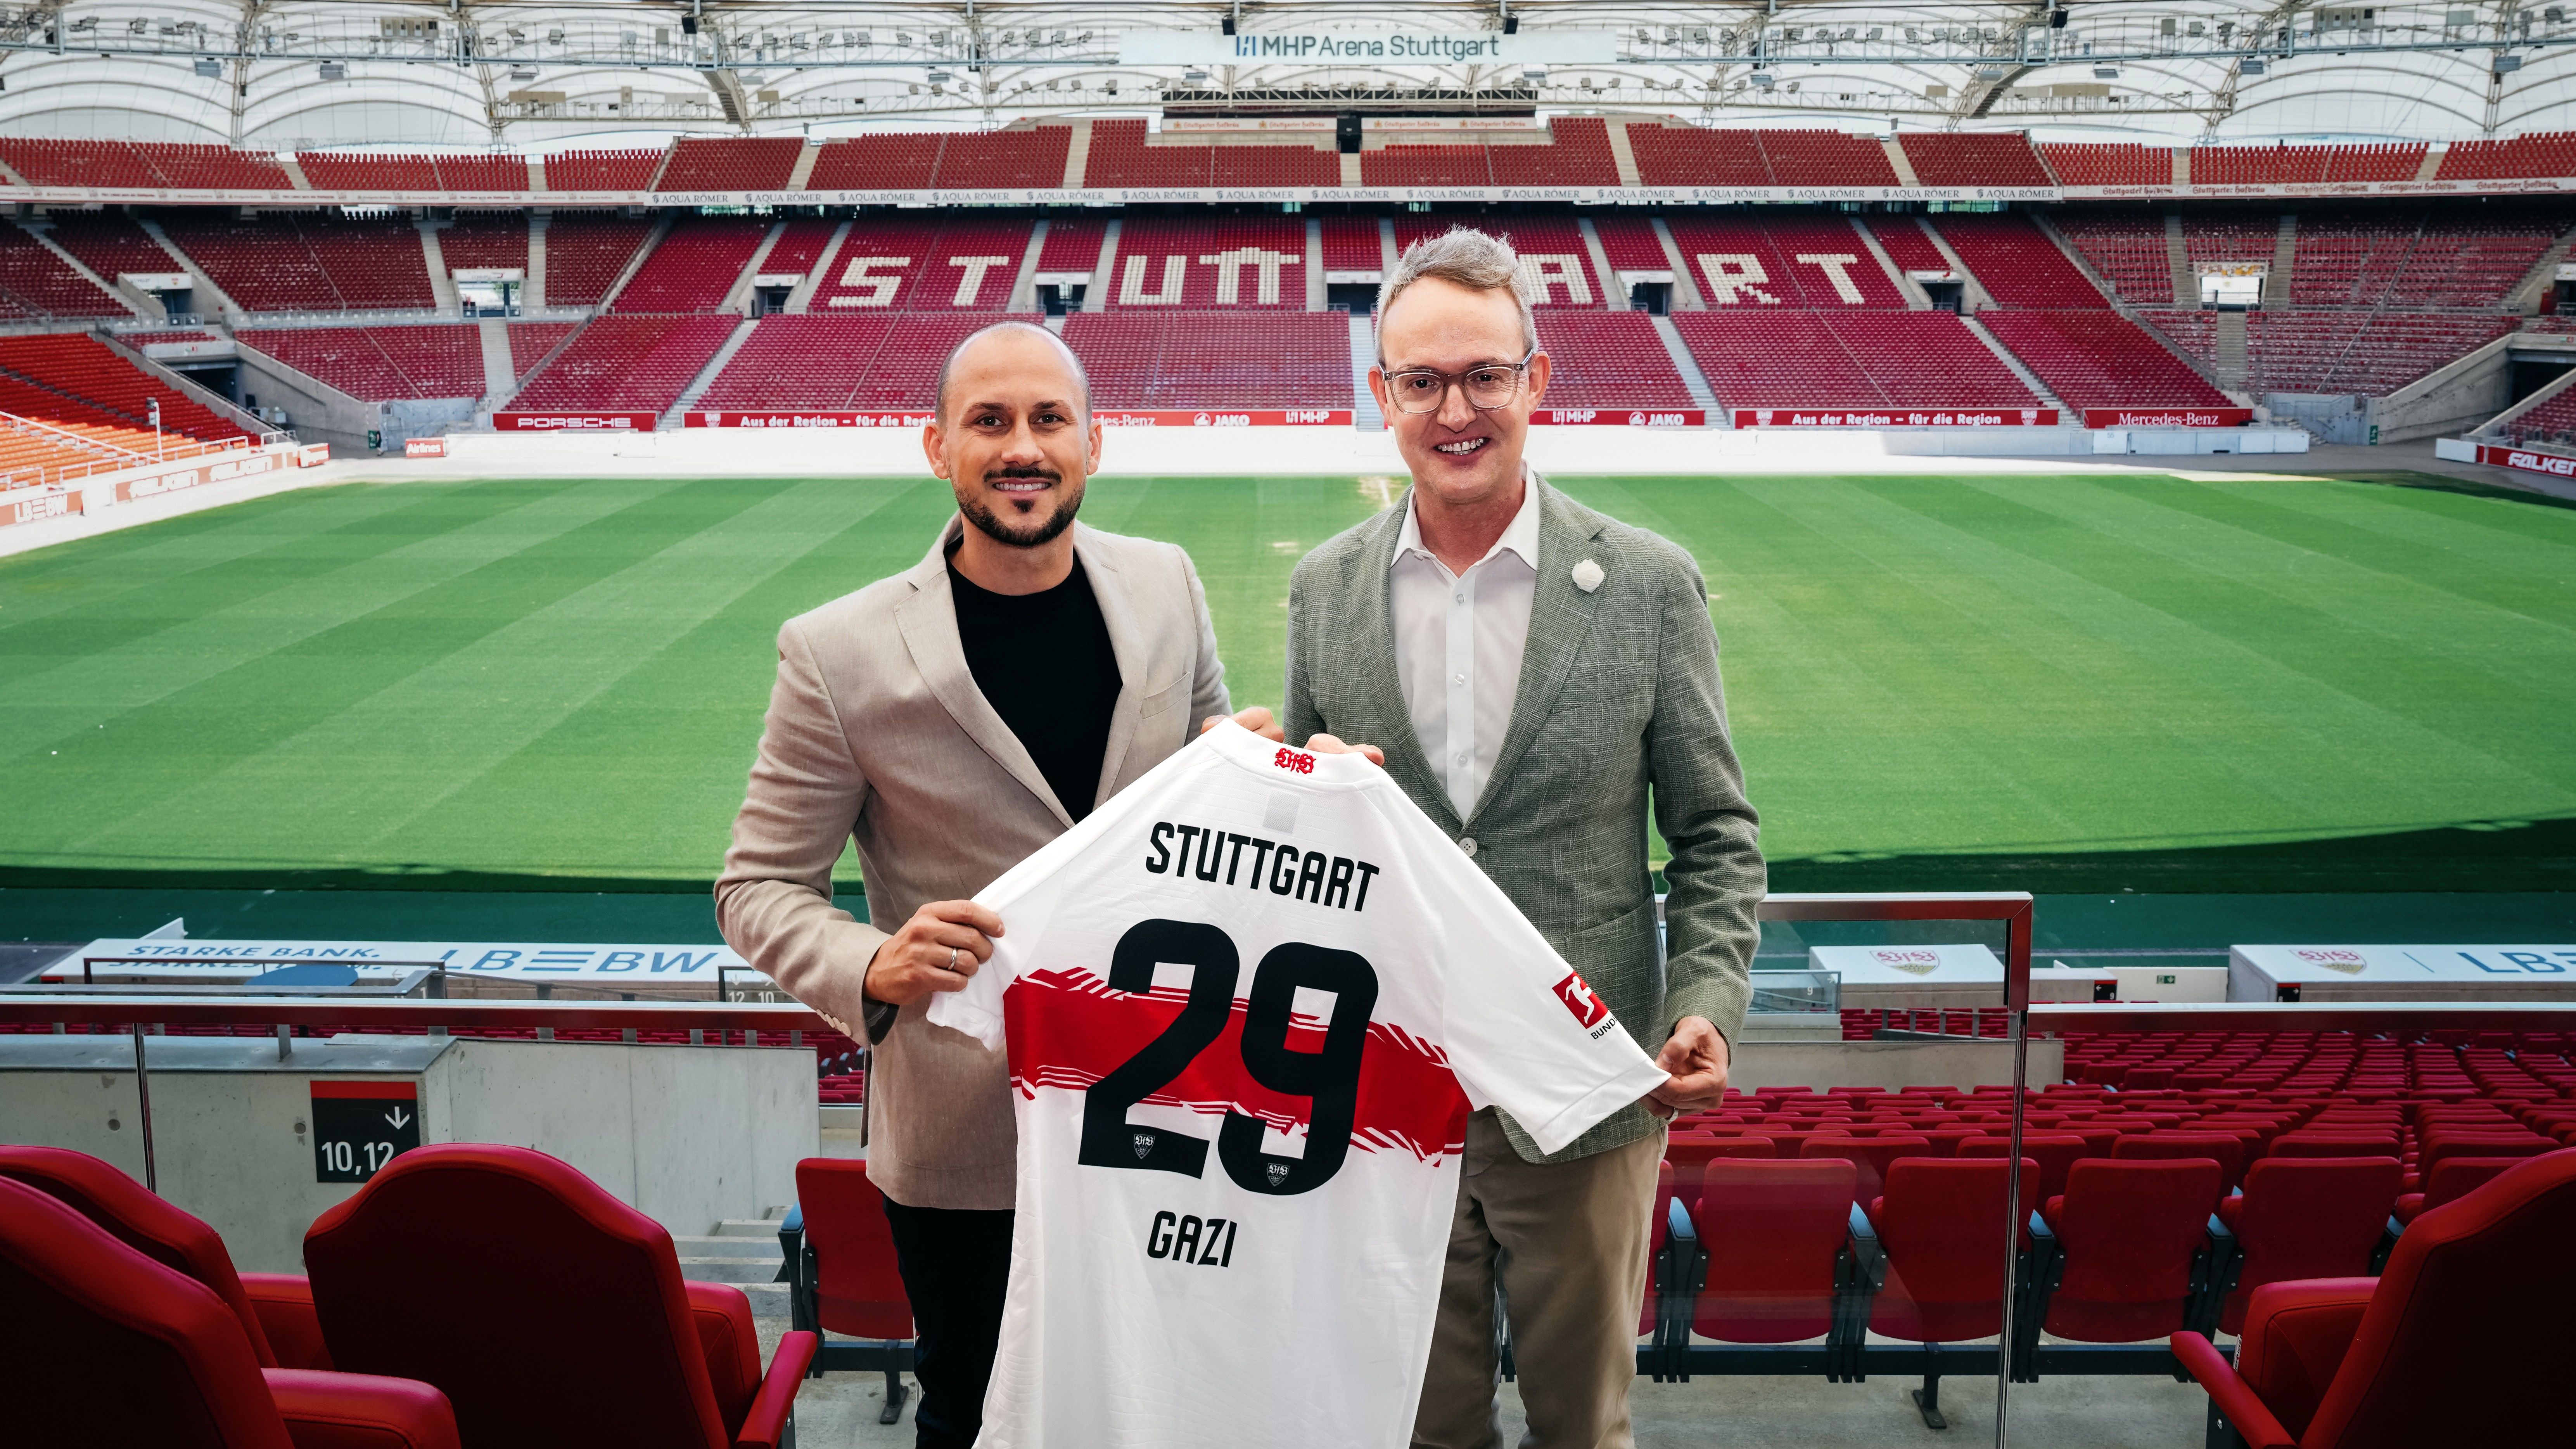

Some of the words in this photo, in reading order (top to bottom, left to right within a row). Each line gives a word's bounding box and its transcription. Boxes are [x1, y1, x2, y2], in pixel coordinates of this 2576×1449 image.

[1262, 36, 1316, 56] MHP
[1319, 36, 1383, 56] Arena
[1390, 35, 1499, 61] Stuttgart
[662, 195, 690, 204] AQUA
[694, 193, 728, 202] RÖMER
[755, 194, 783, 202] AQUA
[787, 192, 821, 201] RÖMER
[849, 194, 877, 202] AQUA
[880, 192, 915, 201] RÖMER
[942, 193, 971, 202] AQUA
[975, 191, 1009, 200] RÖMER
[1037, 192, 1065, 201] AQUA
[1069, 190, 1104, 199] RÖMER
[1131, 192, 1160, 201] AQUA
[1164, 190, 1199, 199] RÖMER
[1226, 191, 1255, 200] AQUA
[1259, 189, 1293, 198] RÖMER
[1321, 191, 1350, 199] AQUA
[1354, 189, 1389, 198] RÖMER
[1416, 190, 1445, 199] AQUA
[1449, 188, 1485, 197] RÖMER
[1511, 190, 1541, 199] AQUA
[1544, 188, 1580, 197] RÖMER
[1607, 190, 1636, 199] AQUA
[1640, 188, 1675, 197] RÖMER
[1702, 190, 1731, 199] AQUA
[1735, 188, 1769, 197] RÖMER
[1797, 190, 1826, 199] AQUA
[1830, 188, 1865, 197] RÖMER
[1892, 190, 1921, 198] AQUA
[1924, 188, 1959, 197] RÖMER
[1986, 189, 2015, 198] AQUA
[2019, 188, 2054, 197] RÖMER
[740, 416, 764, 427] Aus
[768, 415, 789, 427] der
[794, 415, 837, 427] Region
[856, 415, 876, 427] für
[879, 415, 899, 427] die
[903, 415, 935, 427] Regi
[1213, 415, 1250, 426] JAKO
[1300, 412, 1329, 423] MHP
[1566, 411, 1596, 422] MHP
[1648, 413, 1684, 425] JAKO
[1792, 414, 1817, 425] Aus
[1820, 413, 1842, 425] der
[1846, 413, 1890, 426] Region
[1909, 413, 1929, 425] für
[1933, 413, 1952, 425] die
[1957, 413, 2001, 426] Region
[2118, 412, 2219, 426] Mercedes-Benz
[518, 417, 631, 428] PORSCHE
[407, 443, 441, 454] Airlines
[1146, 821, 1380, 912] STUTTGART
[128, 946, 264, 956] STARKE
[271, 948, 381, 957] BANK.
[1807, 986, 1813, 996] 9
[729, 991, 745, 1002] 12
[758, 991, 774, 1003] 10
[1079, 918, 1379, 1196] 29
[322, 1141, 394, 1175] 10,12
[1147, 1211, 1237, 1267] GAZI
